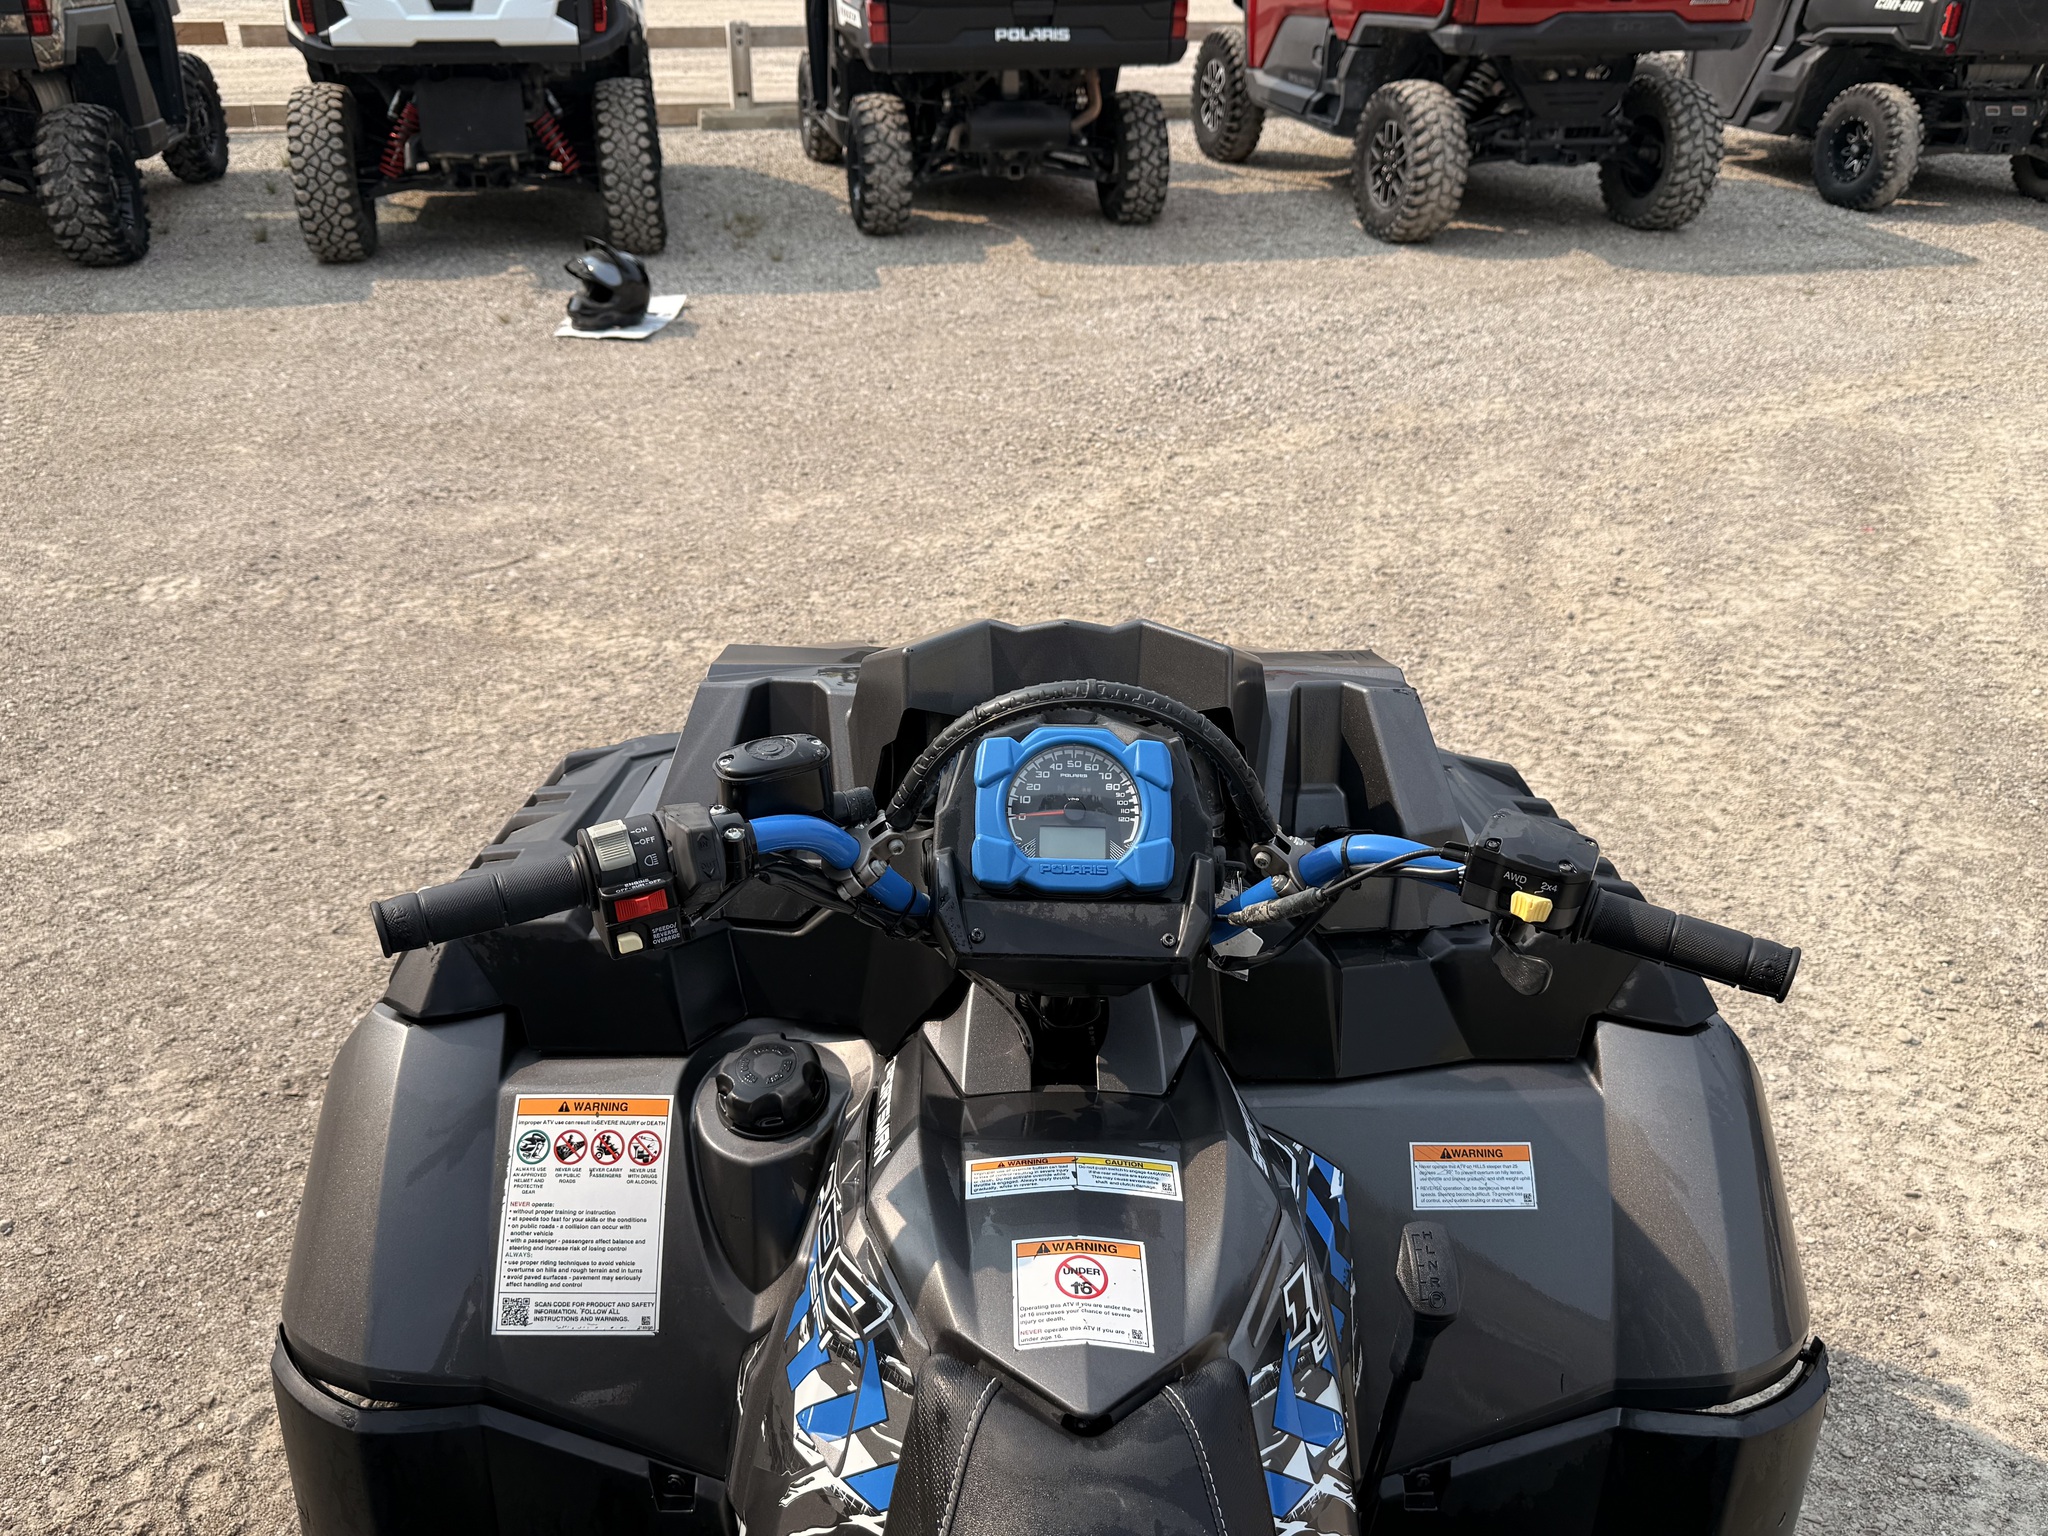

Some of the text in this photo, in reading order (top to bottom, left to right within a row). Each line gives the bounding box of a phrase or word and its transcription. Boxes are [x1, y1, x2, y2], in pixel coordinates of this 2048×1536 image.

[995, 27, 1070, 42] POLARIS
[1039, 864, 1108, 875] POLARIS
[1503, 871, 1527, 884] AWD
[1541, 882, 1557, 892] 2x4
[653, 928, 679, 939] REVERSE
[653, 933, 680, 944] OVERRIDE
[574, 1102, 628, 1112] WARNING
[1452, 1149, 1503, 1158] WARNING
[1008, 1158, 1048, 1167] WARNING
[1105, 1159, 1144, 1168] CAUTION
[1422, 1231, 1432, 1239] H
[1052, 1242, 1118, 1254] WARNING
[1426, 1246, 1435, 1254] L
[1428, 1261, 1437, 1270] N
[1063, 1267, 1100, 1276] UNDER
[1071, 1281, 1093, 1295] 16
